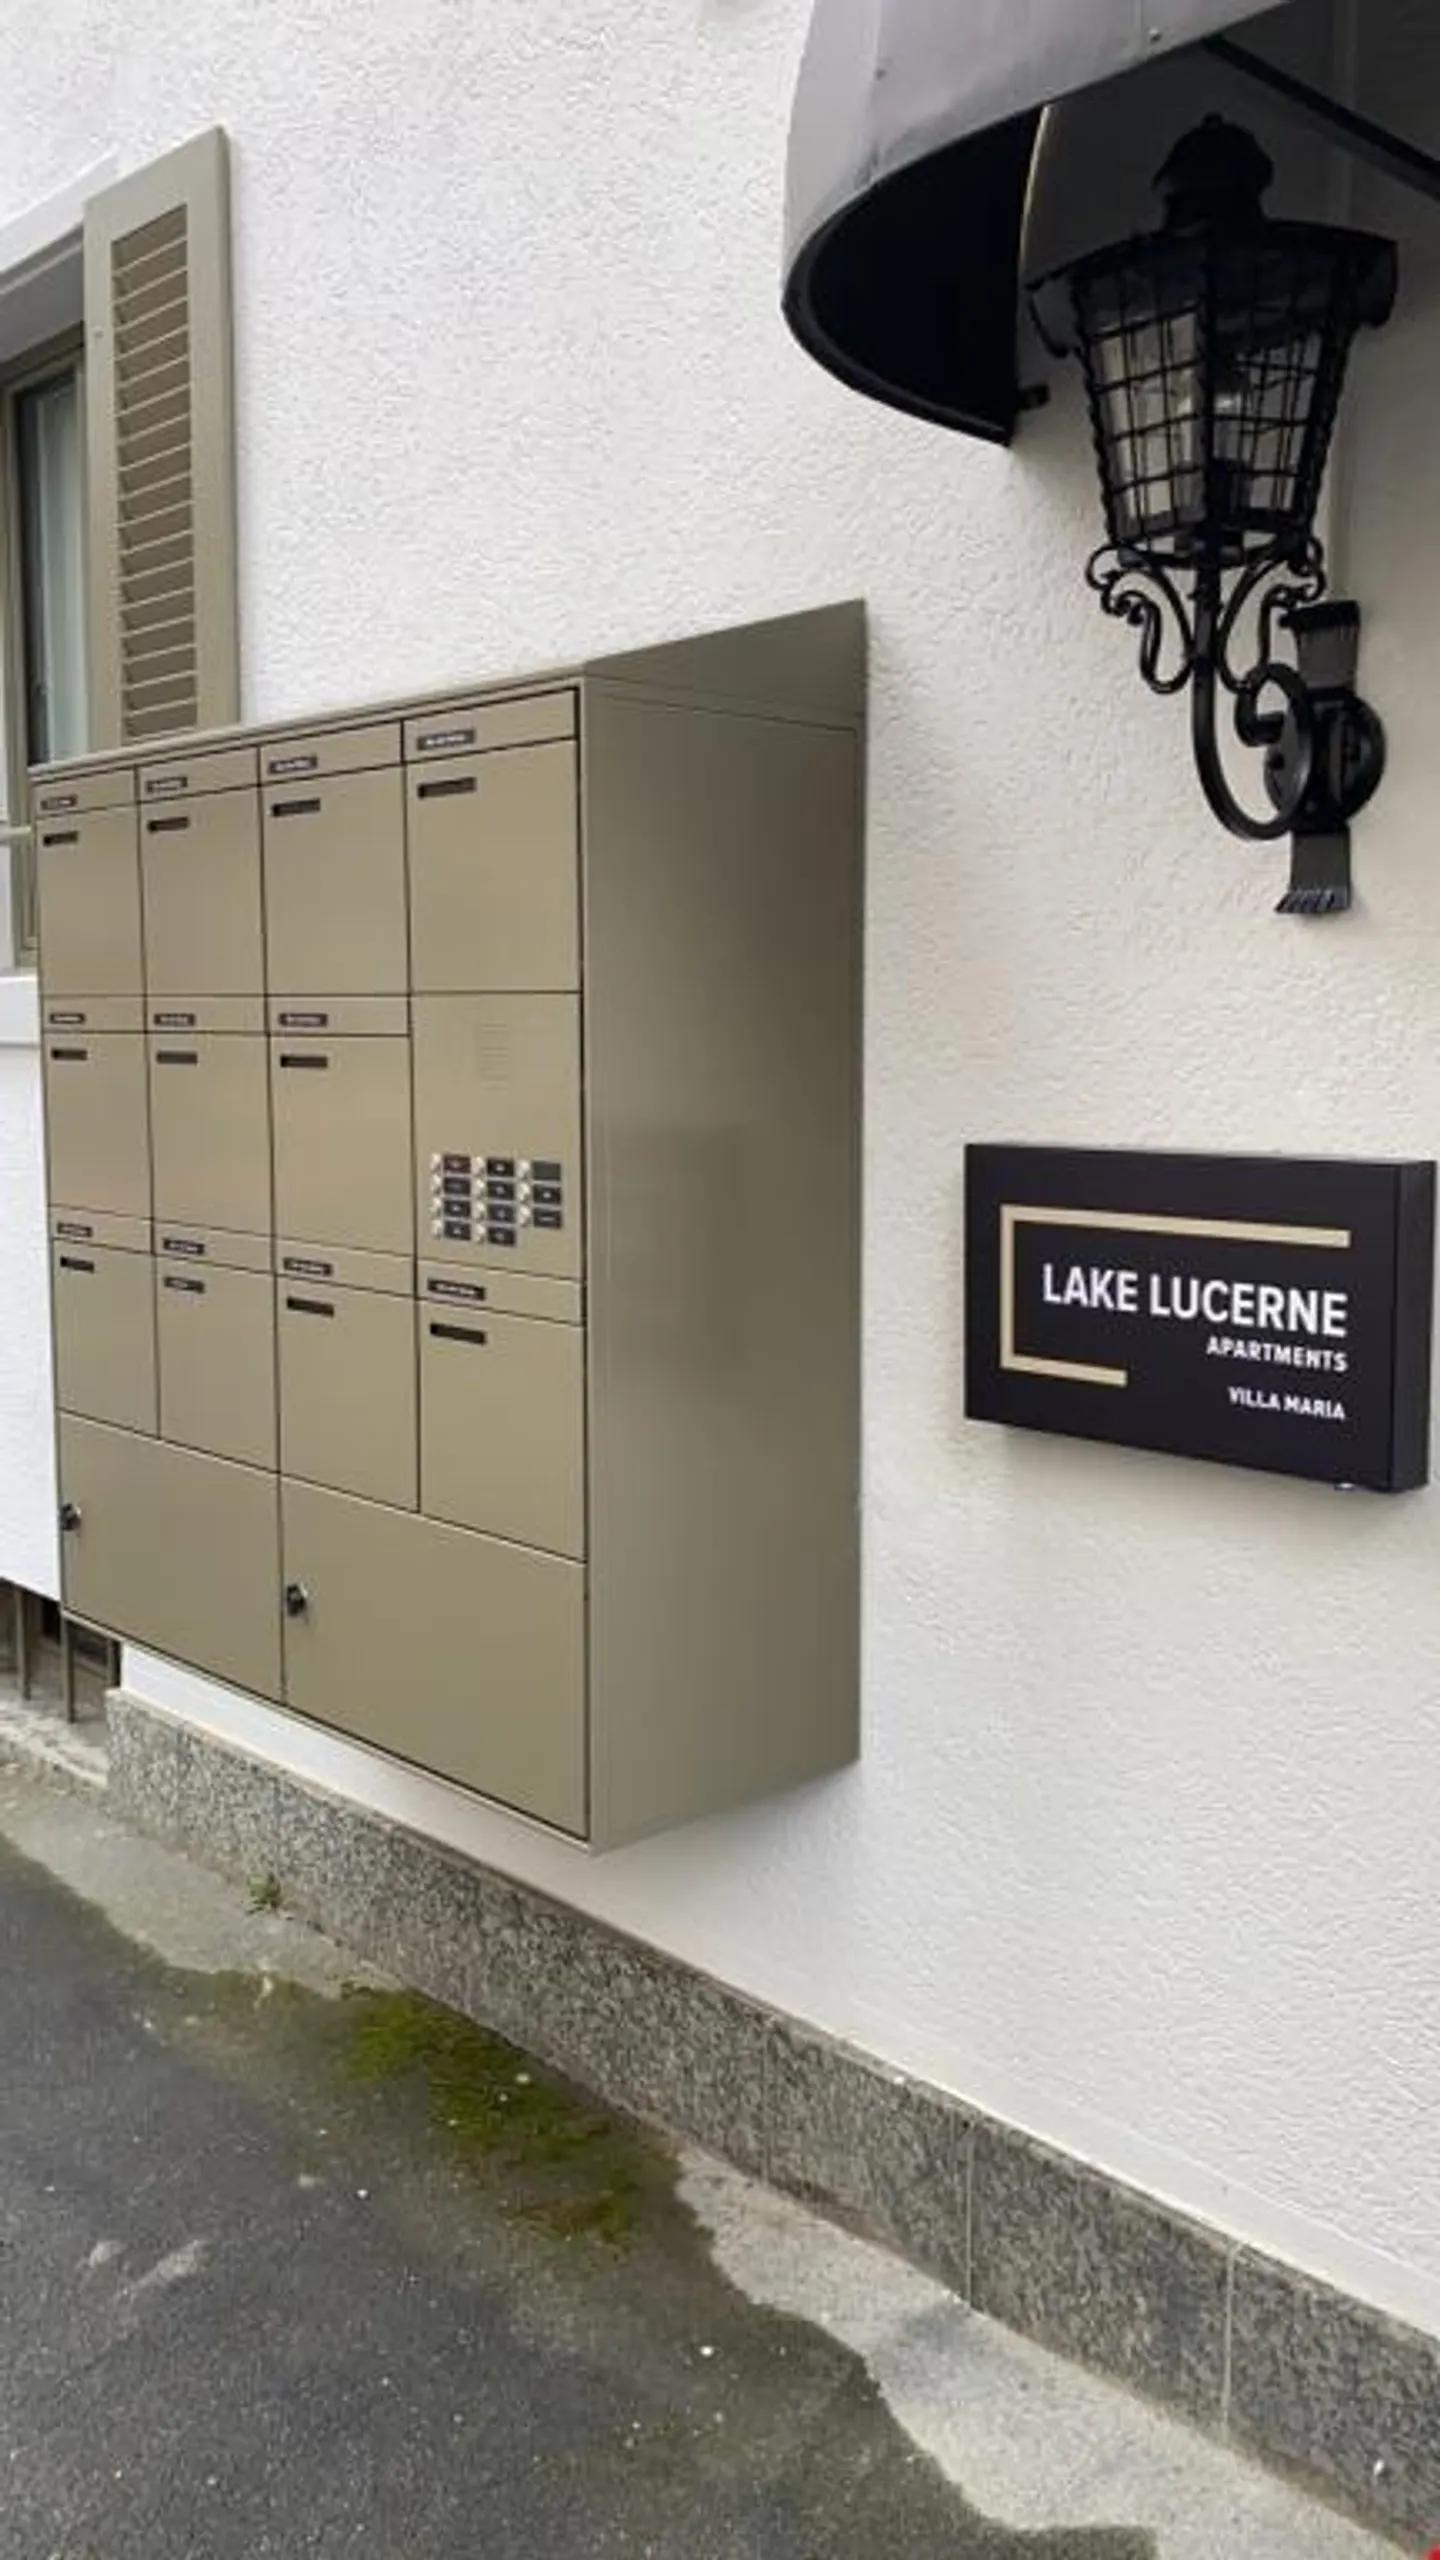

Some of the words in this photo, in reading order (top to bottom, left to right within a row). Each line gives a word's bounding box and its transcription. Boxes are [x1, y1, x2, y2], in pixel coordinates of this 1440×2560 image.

[1042, 1263, 1138, 1312] LAKE
[1150, 1274, 1347, 1337] LUCERNE
[1207, 1337, 1348, 1371] APARTMENTS
[1228, 1386, 1280, 1411] VILLA
[1284, 1392, 1346, 1420] MARIA
